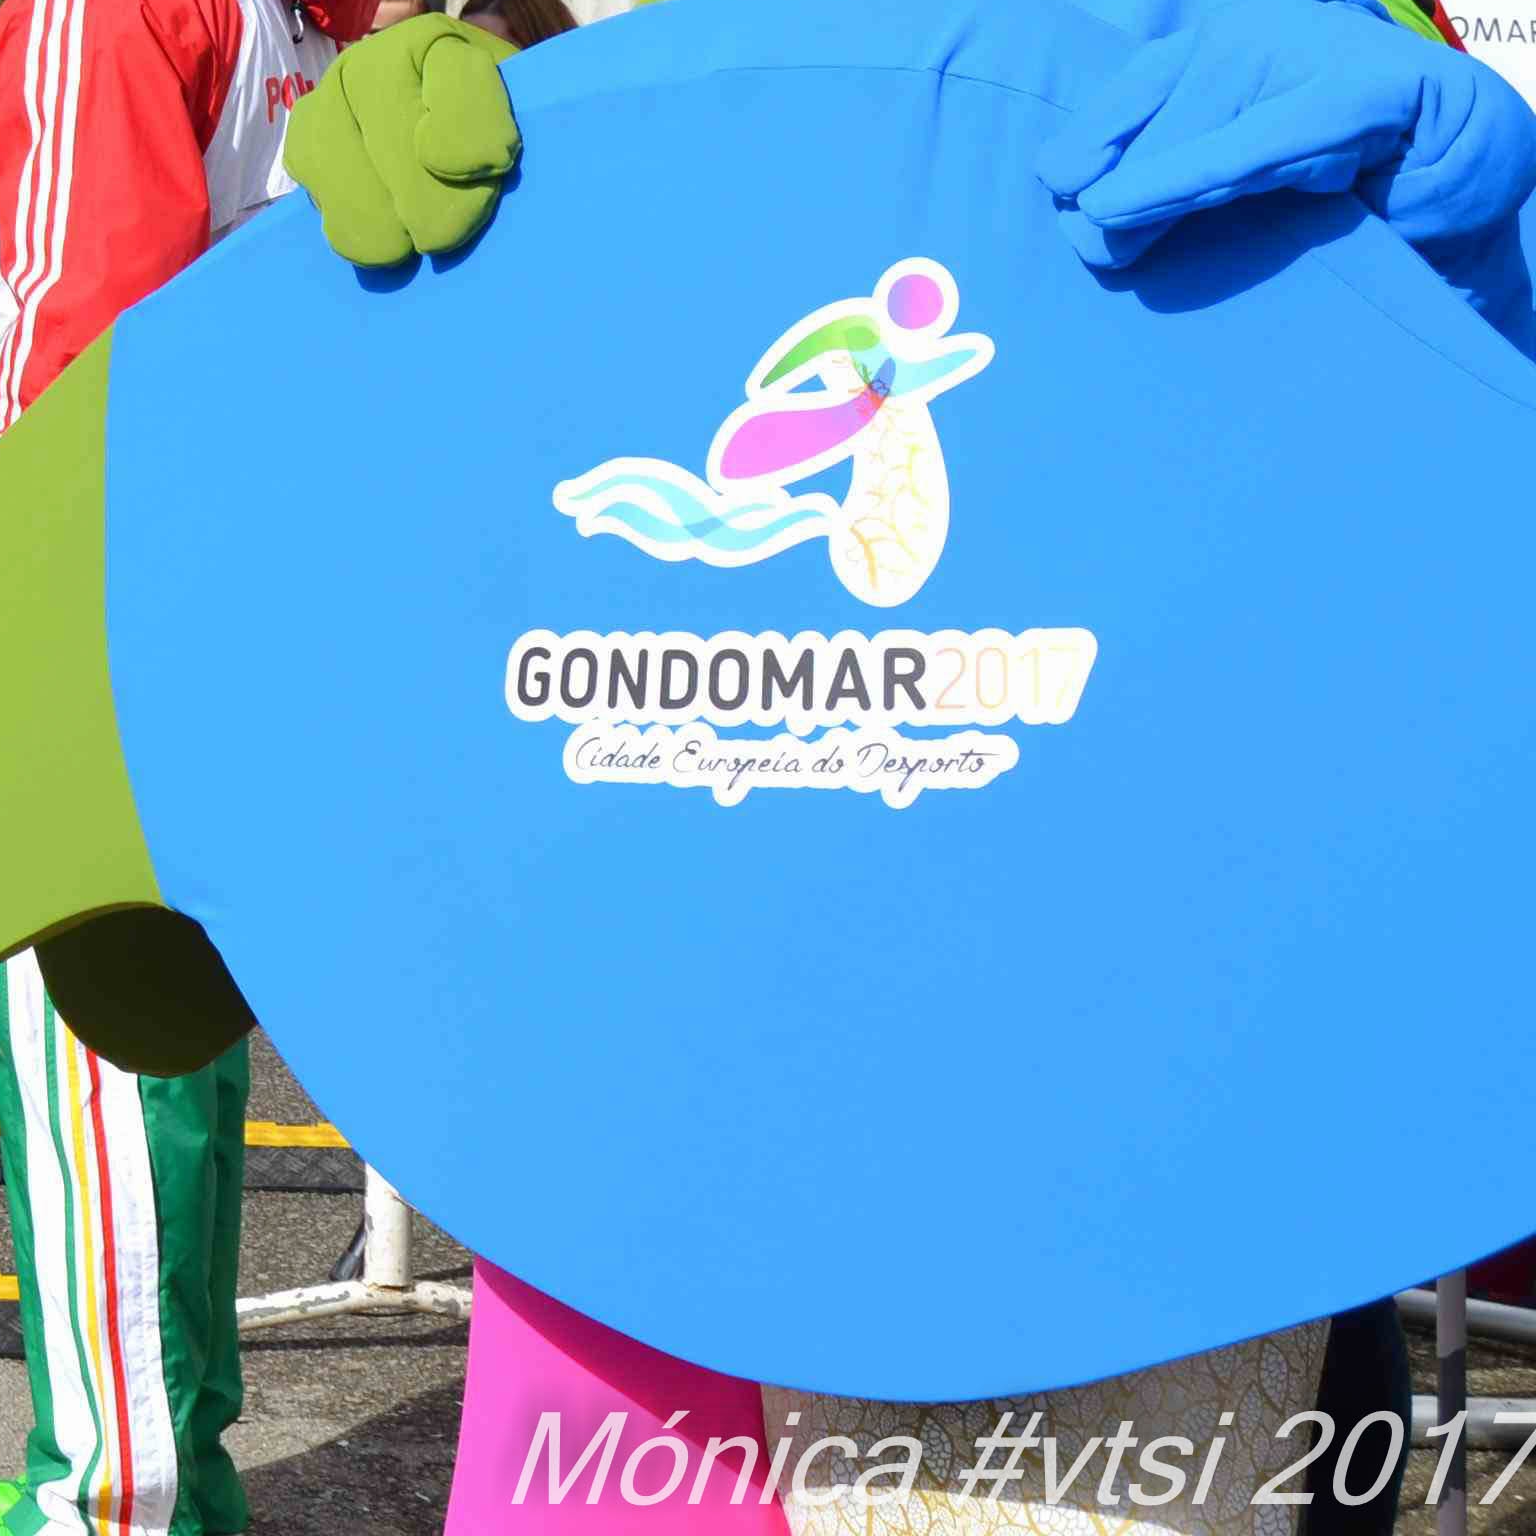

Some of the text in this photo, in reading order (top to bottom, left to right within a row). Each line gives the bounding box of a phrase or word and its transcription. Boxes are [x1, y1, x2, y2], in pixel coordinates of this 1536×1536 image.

[575, 736, 662, 771] Cidade
[811, 743, 846, 774] do
[856, 742, 1002, 794] Desporto
